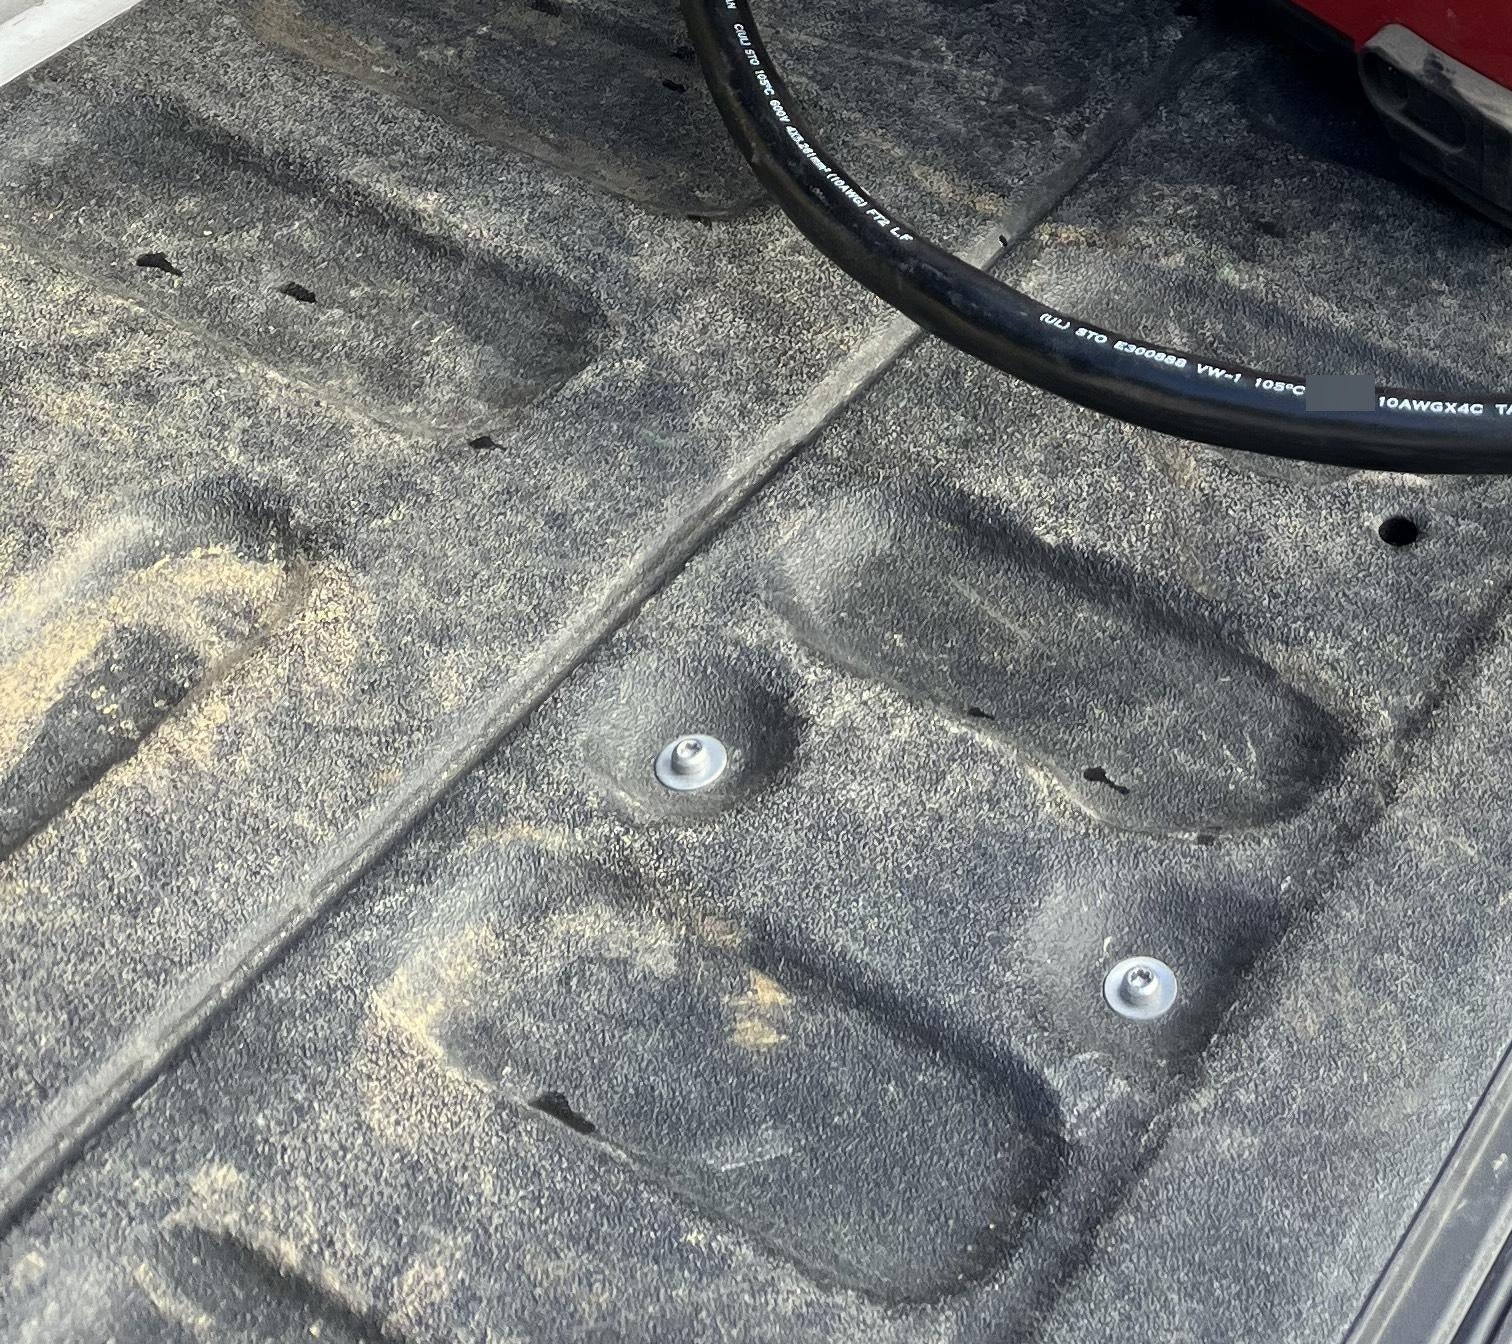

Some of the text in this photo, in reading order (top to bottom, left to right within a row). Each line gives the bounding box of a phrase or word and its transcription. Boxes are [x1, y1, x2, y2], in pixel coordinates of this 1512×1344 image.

[744, 49, 760, 66] STO
[770, 99, 791, 122] 600V
[866, 208, 891, 227] FT2
[1039, 312, 1072, 330] (UL)
[1075, 326, 1108, 344] STO
[1113, 340, 1188, 369] E300888
[1196, 363, 1242, 384] VW-1
[1378, 396, 1485, 416] 10AWGX4C
